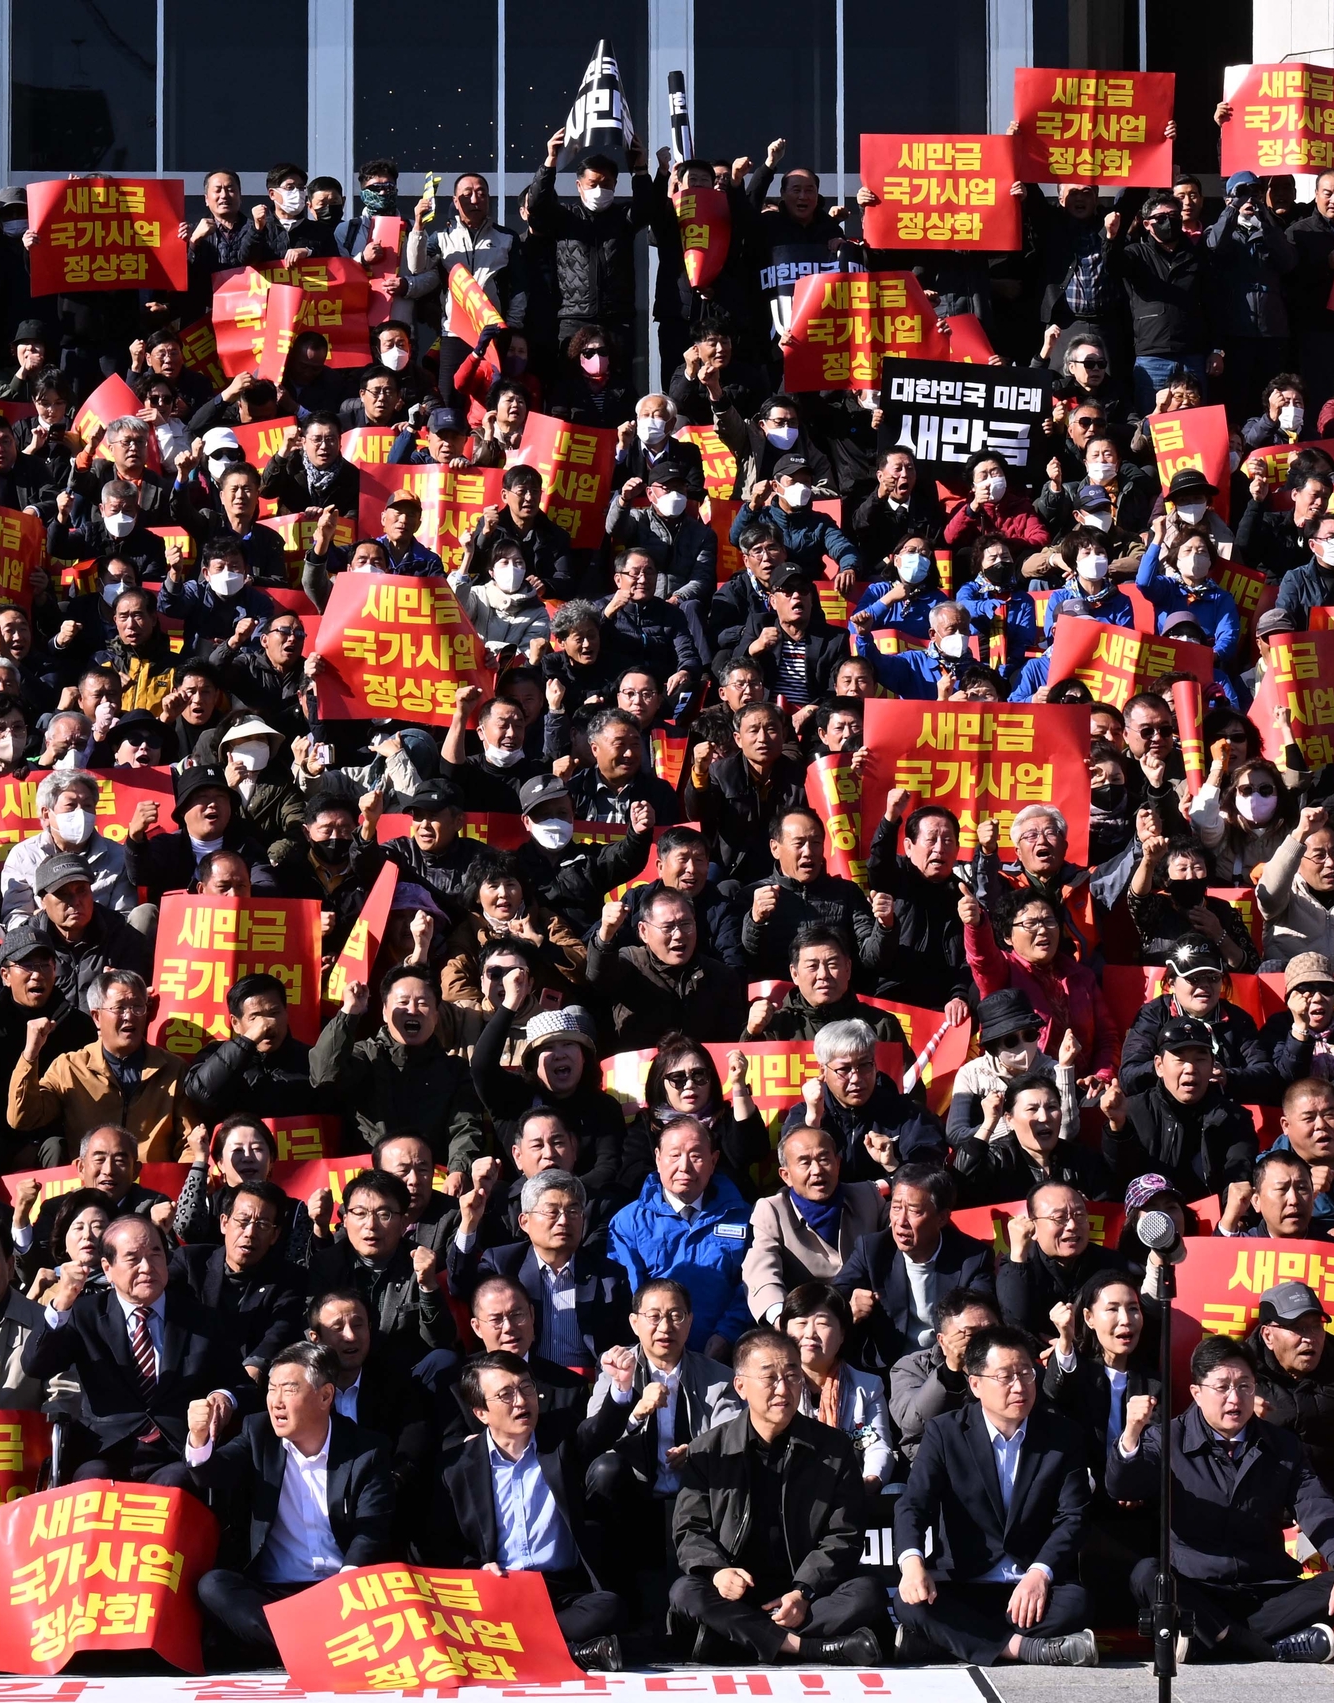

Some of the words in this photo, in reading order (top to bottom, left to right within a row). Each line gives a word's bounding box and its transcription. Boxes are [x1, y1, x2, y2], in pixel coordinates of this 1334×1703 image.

[1052, 78, 1133, 107] 새만금
[1258, 71, 1334, 101] 새만금
[1037, 112, 1146, 142] 국가사업
[898, 143, 982, 170] 새만금
[1049, 148, 1132, 177] 정상화
[1258, 139, 1334, 167] 정상화
[64, 187, 145, 213] 새만금
[883, 177, 996, 205] 국가사업
[51, 221, 160, 248] 국가사업
[898, 212, 983, 240] 정상화
[65, 254, 148, 282] 정상화
[822, 280, 906, 309] 새만금
[234, 300, 342, 331] 국사업
[808, 315, 921, 345] 국가사업
[823, 351, 889, 380] 정상
[891, 378, 986, 408] 대한민국
[994, 386, 1042, 412] 미래
[897, 415, 1031, 465] 새만금
[398, 472, 485, 505] 새만금
[361, 585, 461, 624] 새만금
[342, 628, 476, 670] 국가사업
[1087, 633, 1175, 680] 새만금
[917, 713, 1034, 752] 새만금
[895, 760, 1053, 802] 국가사업
[177, 907, 286, 951] 새만금
[29, 1491, 170, 1551] 새만금
[10, 1536, 184, 1610] 국가사업
[339, 1572, 482, 1624] 새만금
[25, 1588, 155, 1662] 정상화
[325, 1607, 524, 1672] 국가사업
[359, 1646, 517, 1690] 정상화
